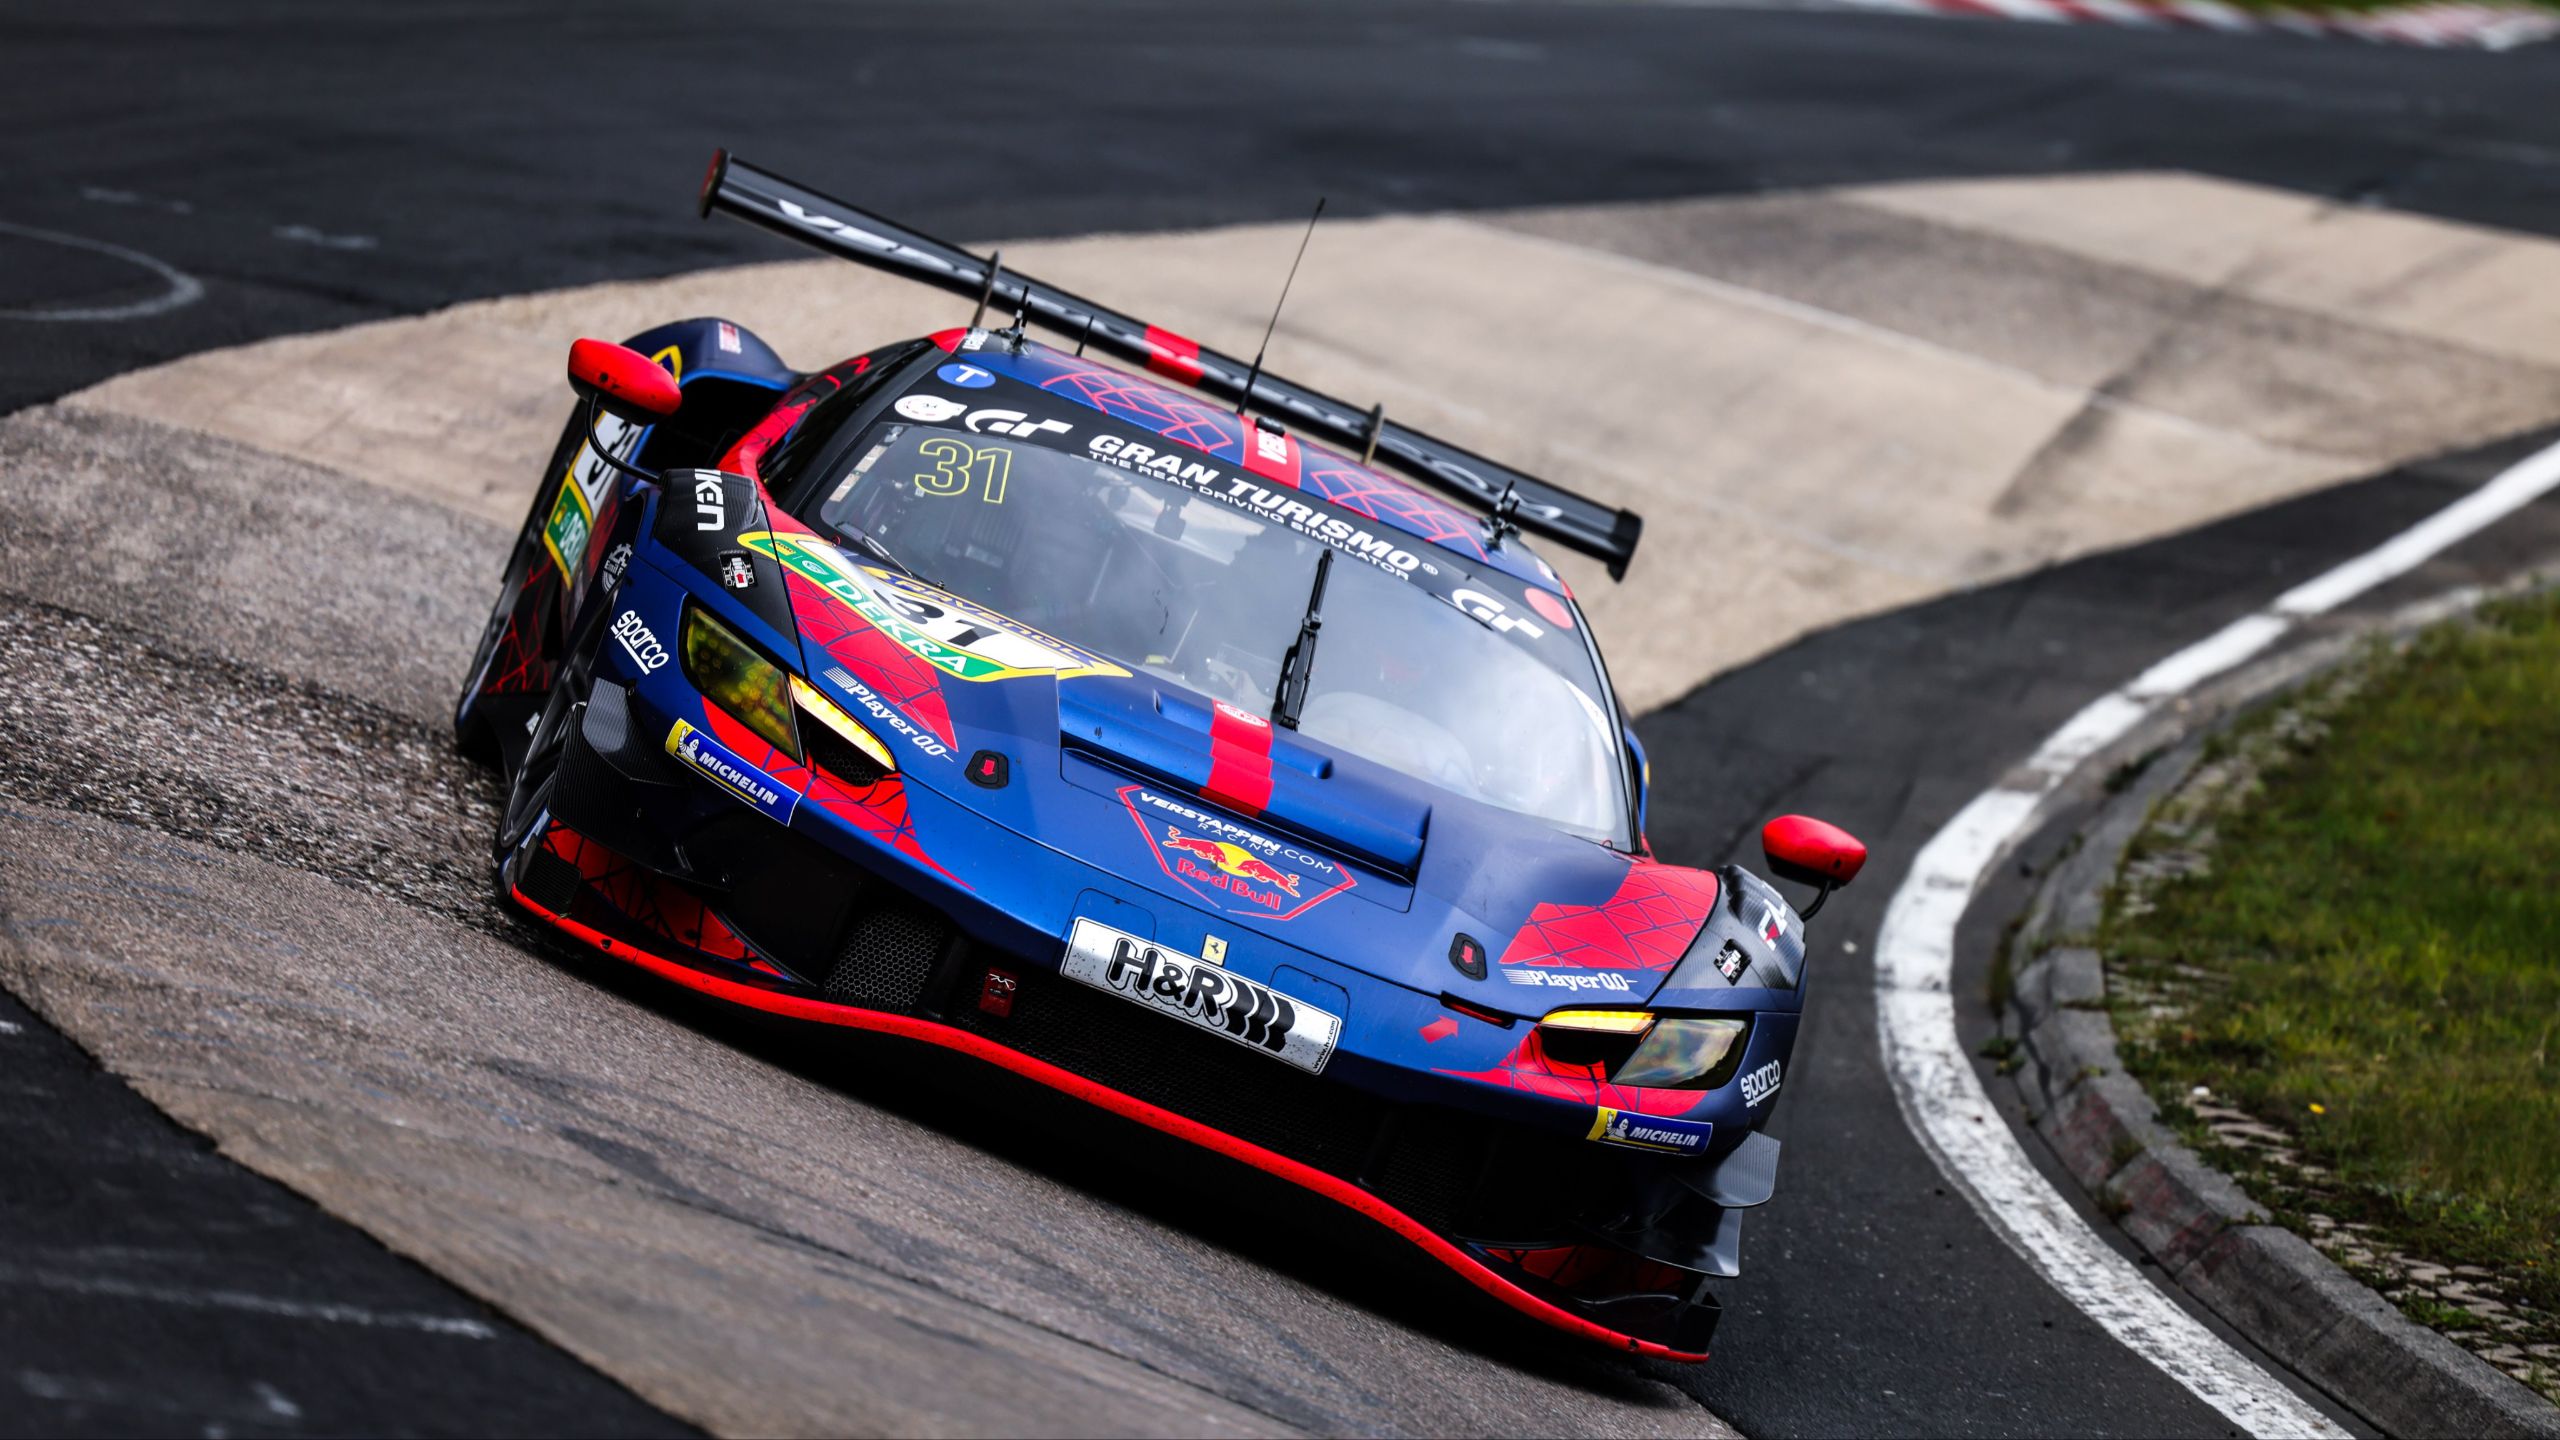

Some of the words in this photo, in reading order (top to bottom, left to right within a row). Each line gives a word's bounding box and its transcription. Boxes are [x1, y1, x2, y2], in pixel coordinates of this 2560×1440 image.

[955, 365, 989, 383] T
[914, 437, 1013, 504] 31
[1088, 434, 1220, 486] GRAN
[1088, 450, 1132, 470] THE
[1138, 465, 1193, 490] REAL
[1199, 485, 1285, 525] DRIVING
[1290, 519, 1409, 581] SIMULATOR
[613, 609, 671, 671] sparco
[825, 578, 968, 674] DEKRA
[873, 588, 1003, 648] 31
[699, 752, 779, 806] MICHELIN
[1140, 791, 1334, 875] VERSTAPPEN.COM
[1197, 822, 1277, 858] RACING
[1176, 857, 1230, 891] Red
[1230, 878, 1282, 911] Bull
[1740, 1058, 1781, 1107] sparco
[1630, 1126, 1700, 1147] MICHELIN
